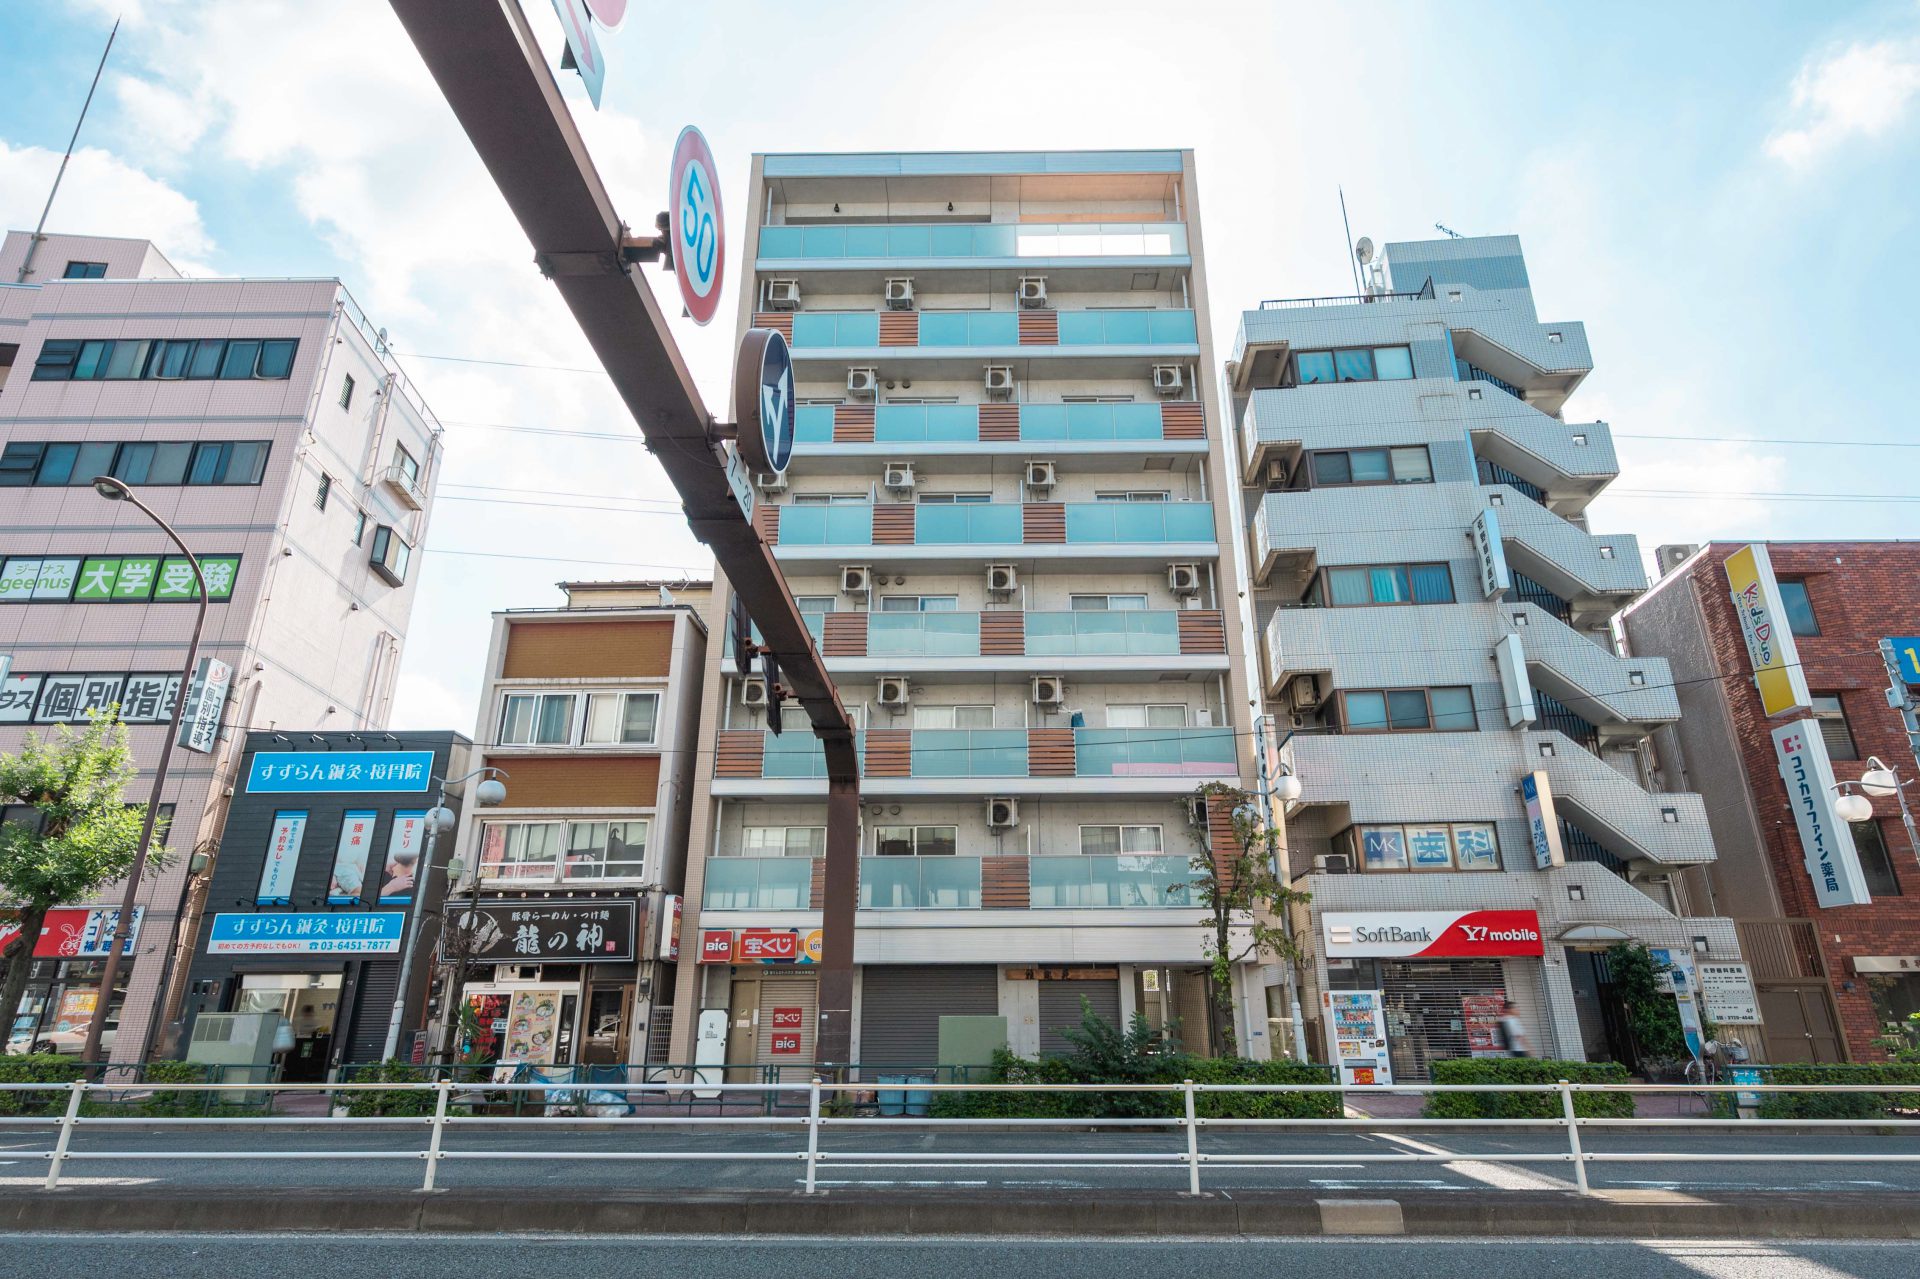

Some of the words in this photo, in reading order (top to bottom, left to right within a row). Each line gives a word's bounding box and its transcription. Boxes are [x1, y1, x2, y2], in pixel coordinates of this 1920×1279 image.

[683, 167, 715, 284] 50
[16, 564, 65, 575] ジーナス
[0, 577, 71, 593] geenus
[80, 563, 232, 594] 大学受験
[1791, 755, 1839, 892] ココカラファイン薬局
[351, 823, 364, 846] 腰痛
[402, 819, 414, 848] 肩こり
[1370, 837, 1399, 852] MK
[1412, 829, 1495, 864] 歯科
[511, 910, 609, 921] 豚骨らーめん・つけ麺
[1356, 926, 1434, 943] SoftBank
[320, 941, 391, 950] 03-6451-7877
[744, 937, 792, 954] 宝くじ
[775, 1013, 800, 1023] 宝くじ
